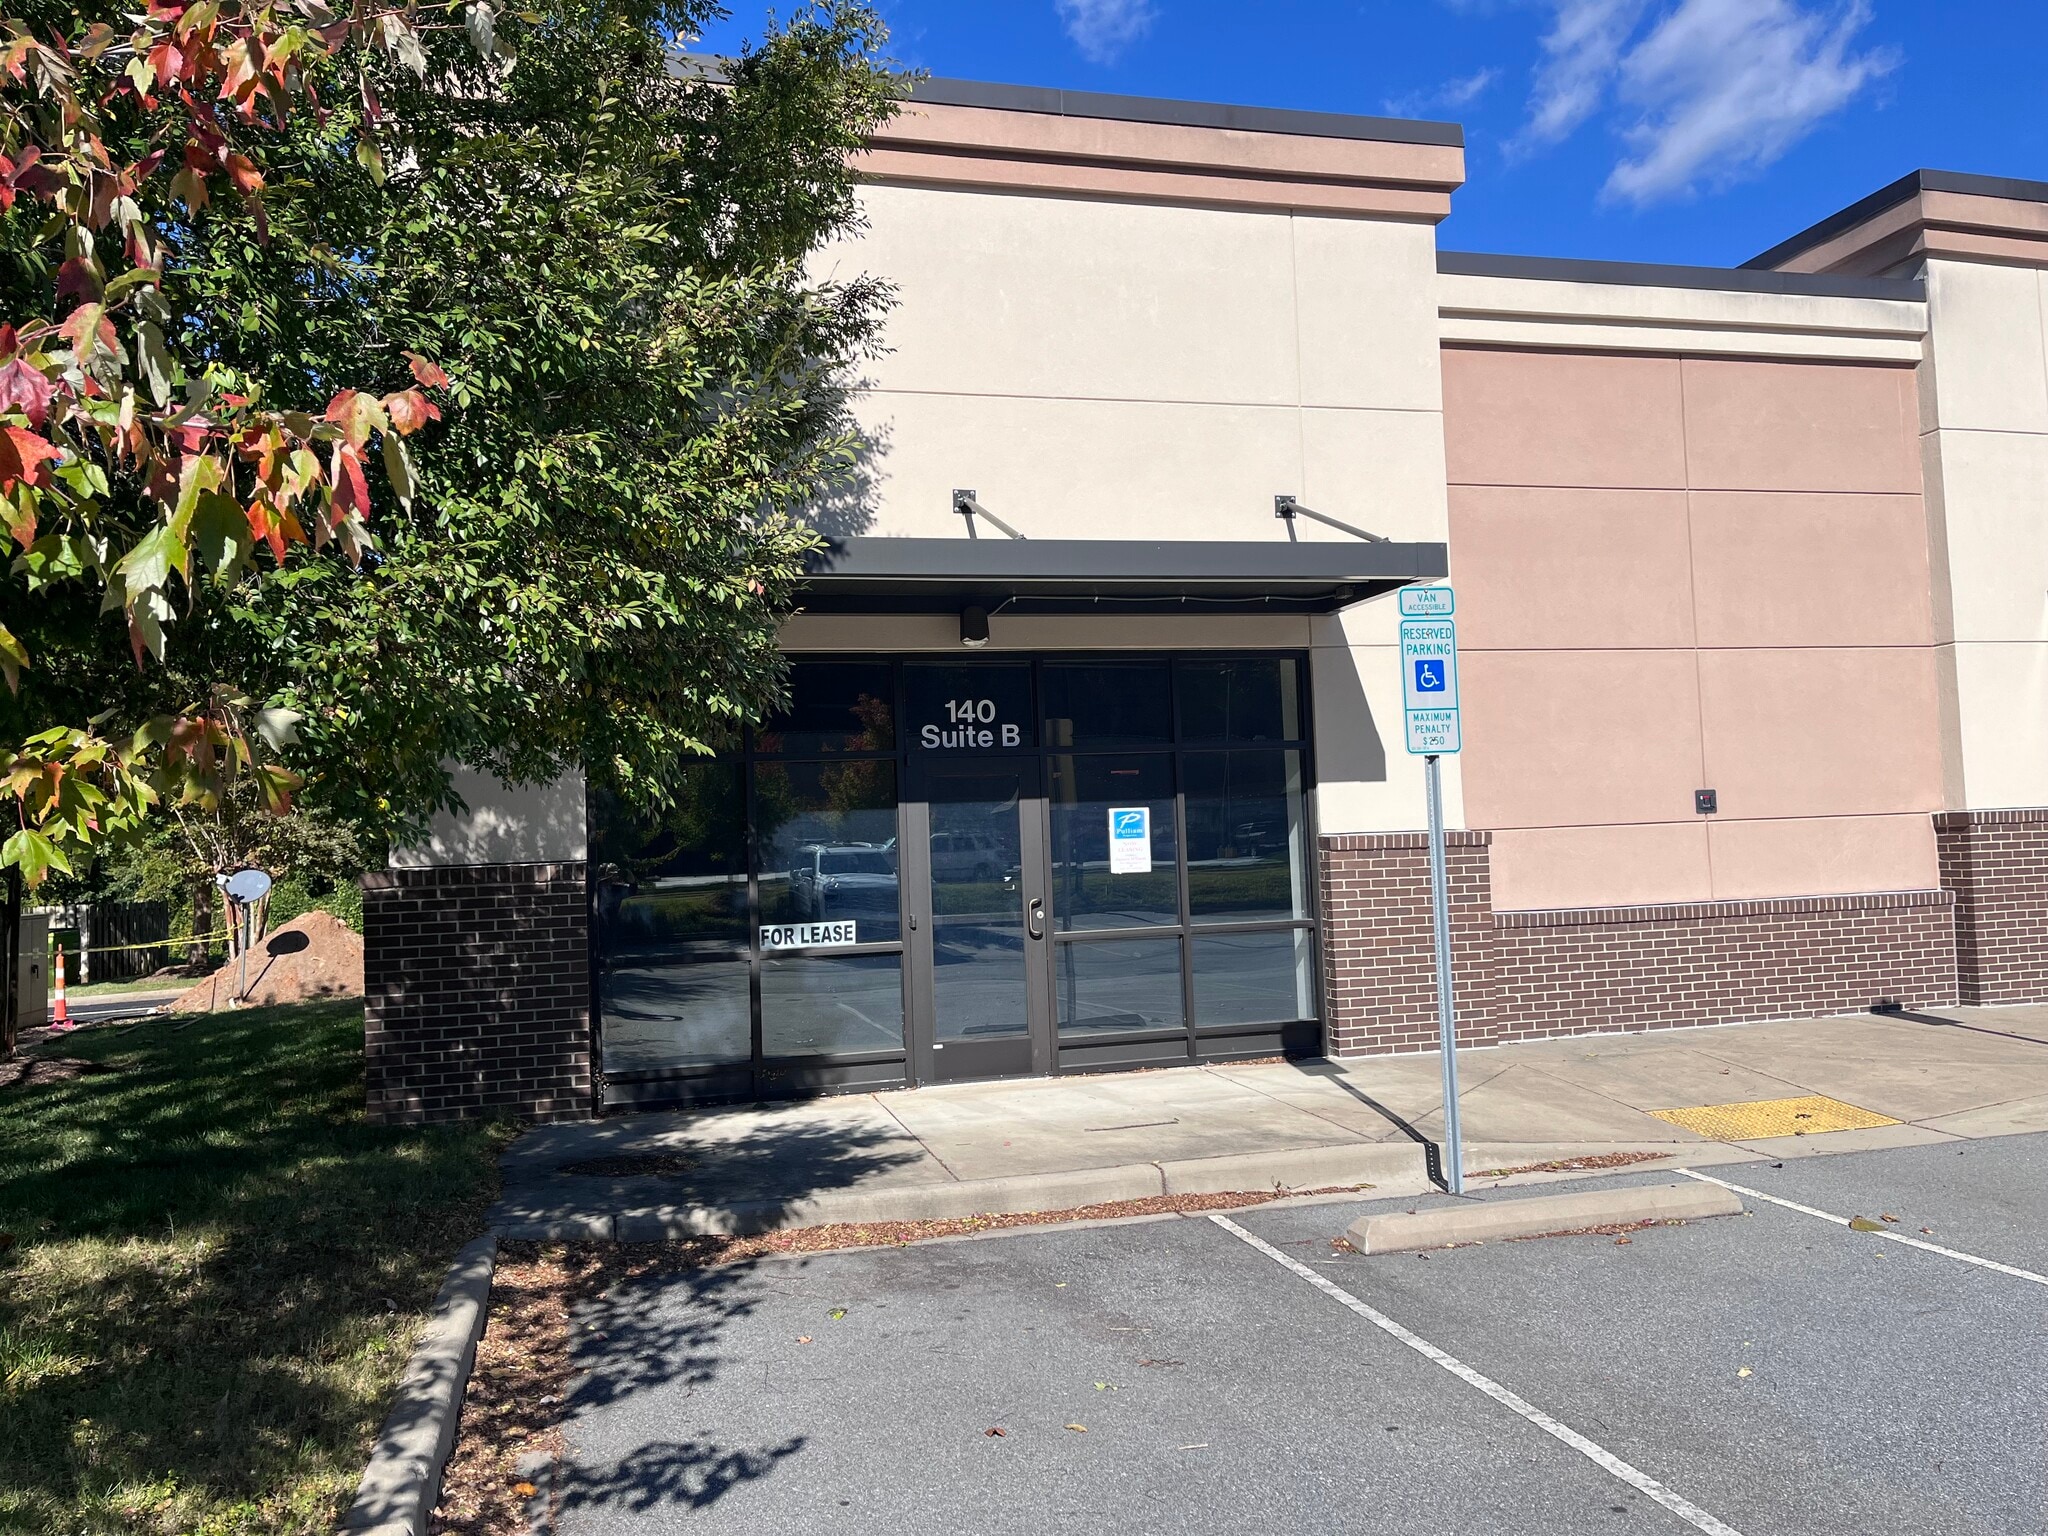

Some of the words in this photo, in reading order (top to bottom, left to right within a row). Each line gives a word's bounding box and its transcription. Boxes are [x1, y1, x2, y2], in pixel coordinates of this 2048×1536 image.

[1416, 593, 1437, 603] VAN
[1408, 603, 1447, 611] ACCESSIBLE
[1403, 627, 1452, 640] RESERVED
[1406, 643, 1451, 656] PARKING
[944, 699, 996, 724] 140
[1413, 712, 1452, 722] MAXIMUM
[1414, 724, 1451, 734] PENALTY
[921, 724, 994, 749] Suite
[1001, 723, 1021, 747] B
[1422, 735, 1445, 746] $250
[760, 927, 795, 946] FOR
[800, 924, 854, 944] LEASE
